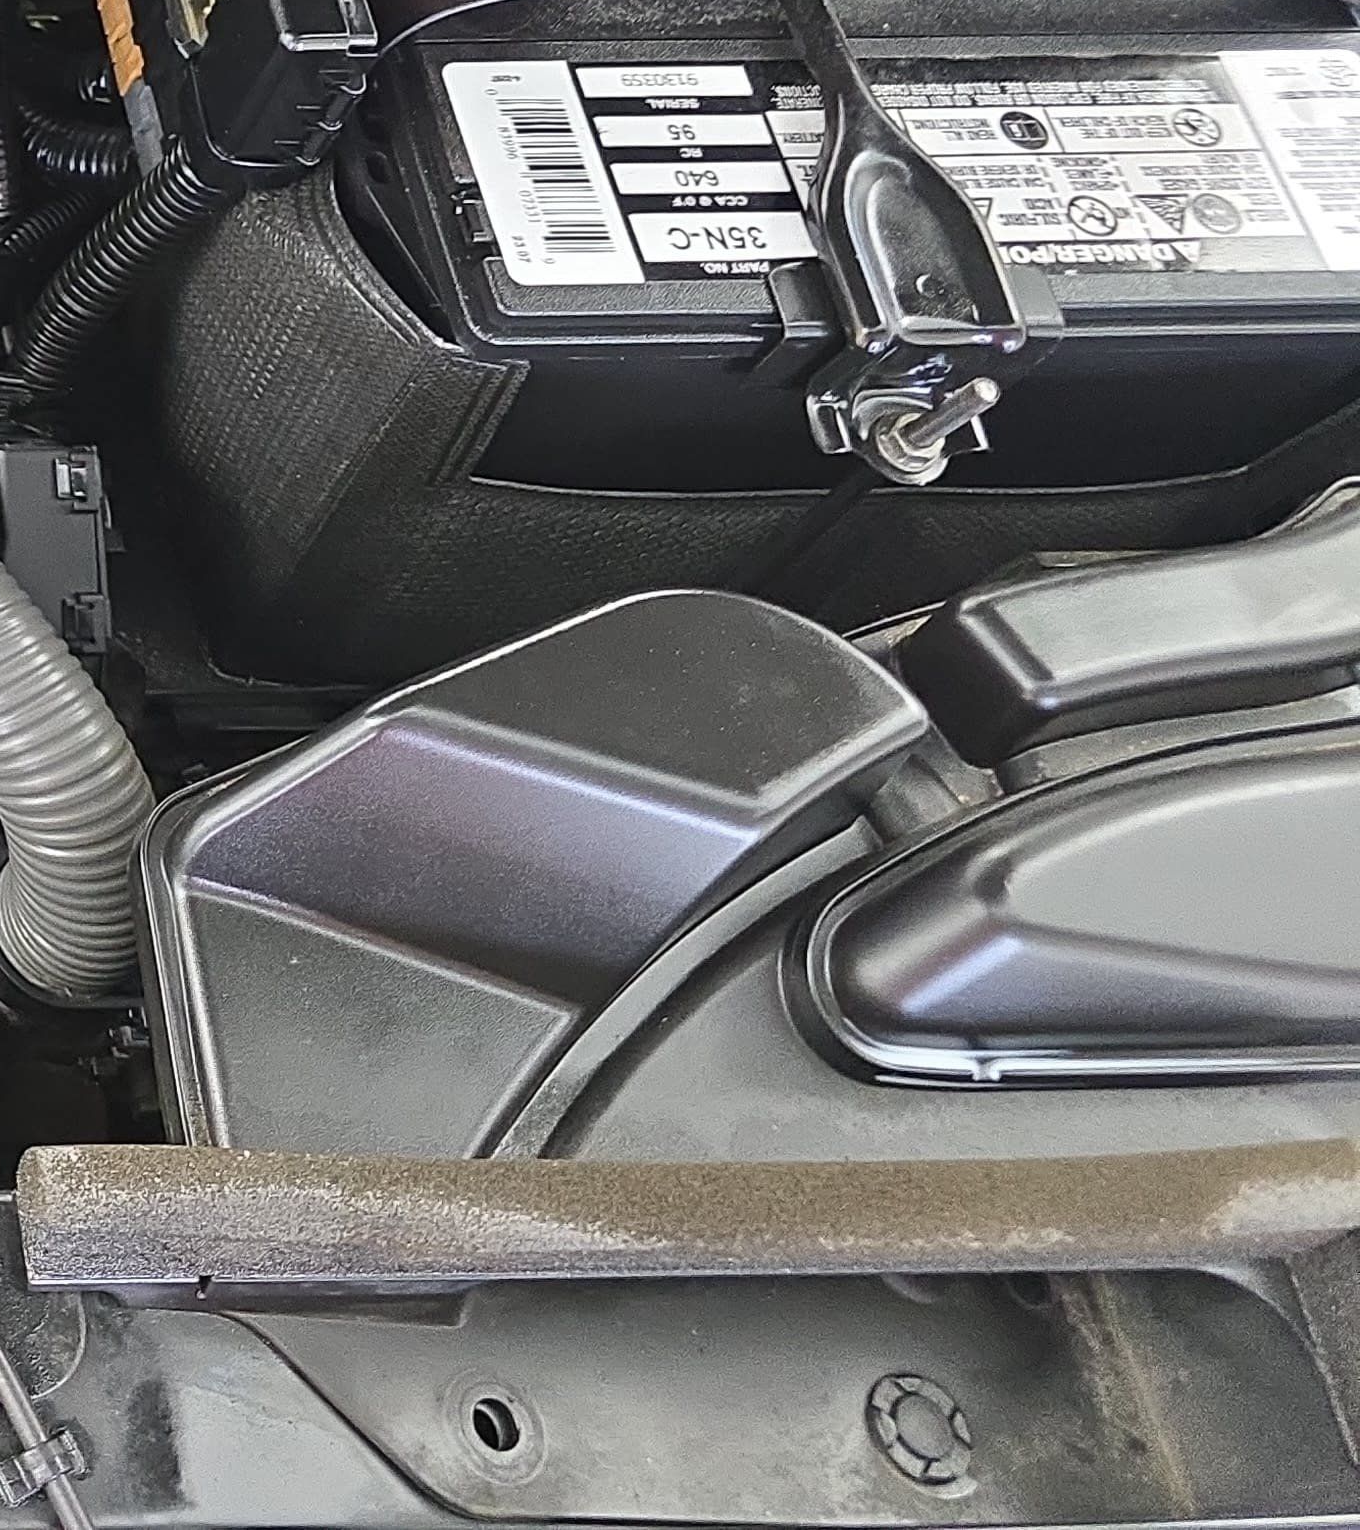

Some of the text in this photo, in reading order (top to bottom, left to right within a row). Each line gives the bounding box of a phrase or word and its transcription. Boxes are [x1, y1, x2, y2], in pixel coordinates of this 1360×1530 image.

[645, 98, 700, 110] SERIAL
[667, 124, 697, 141] 95
[679, 147, 704, 158] RC
[675, 170, 719, 187] 640
[714, 196, 749, 207] CCA
[666, 226, 768, 250] 35N-C
[700, 261, 770, 274] PART NO.
